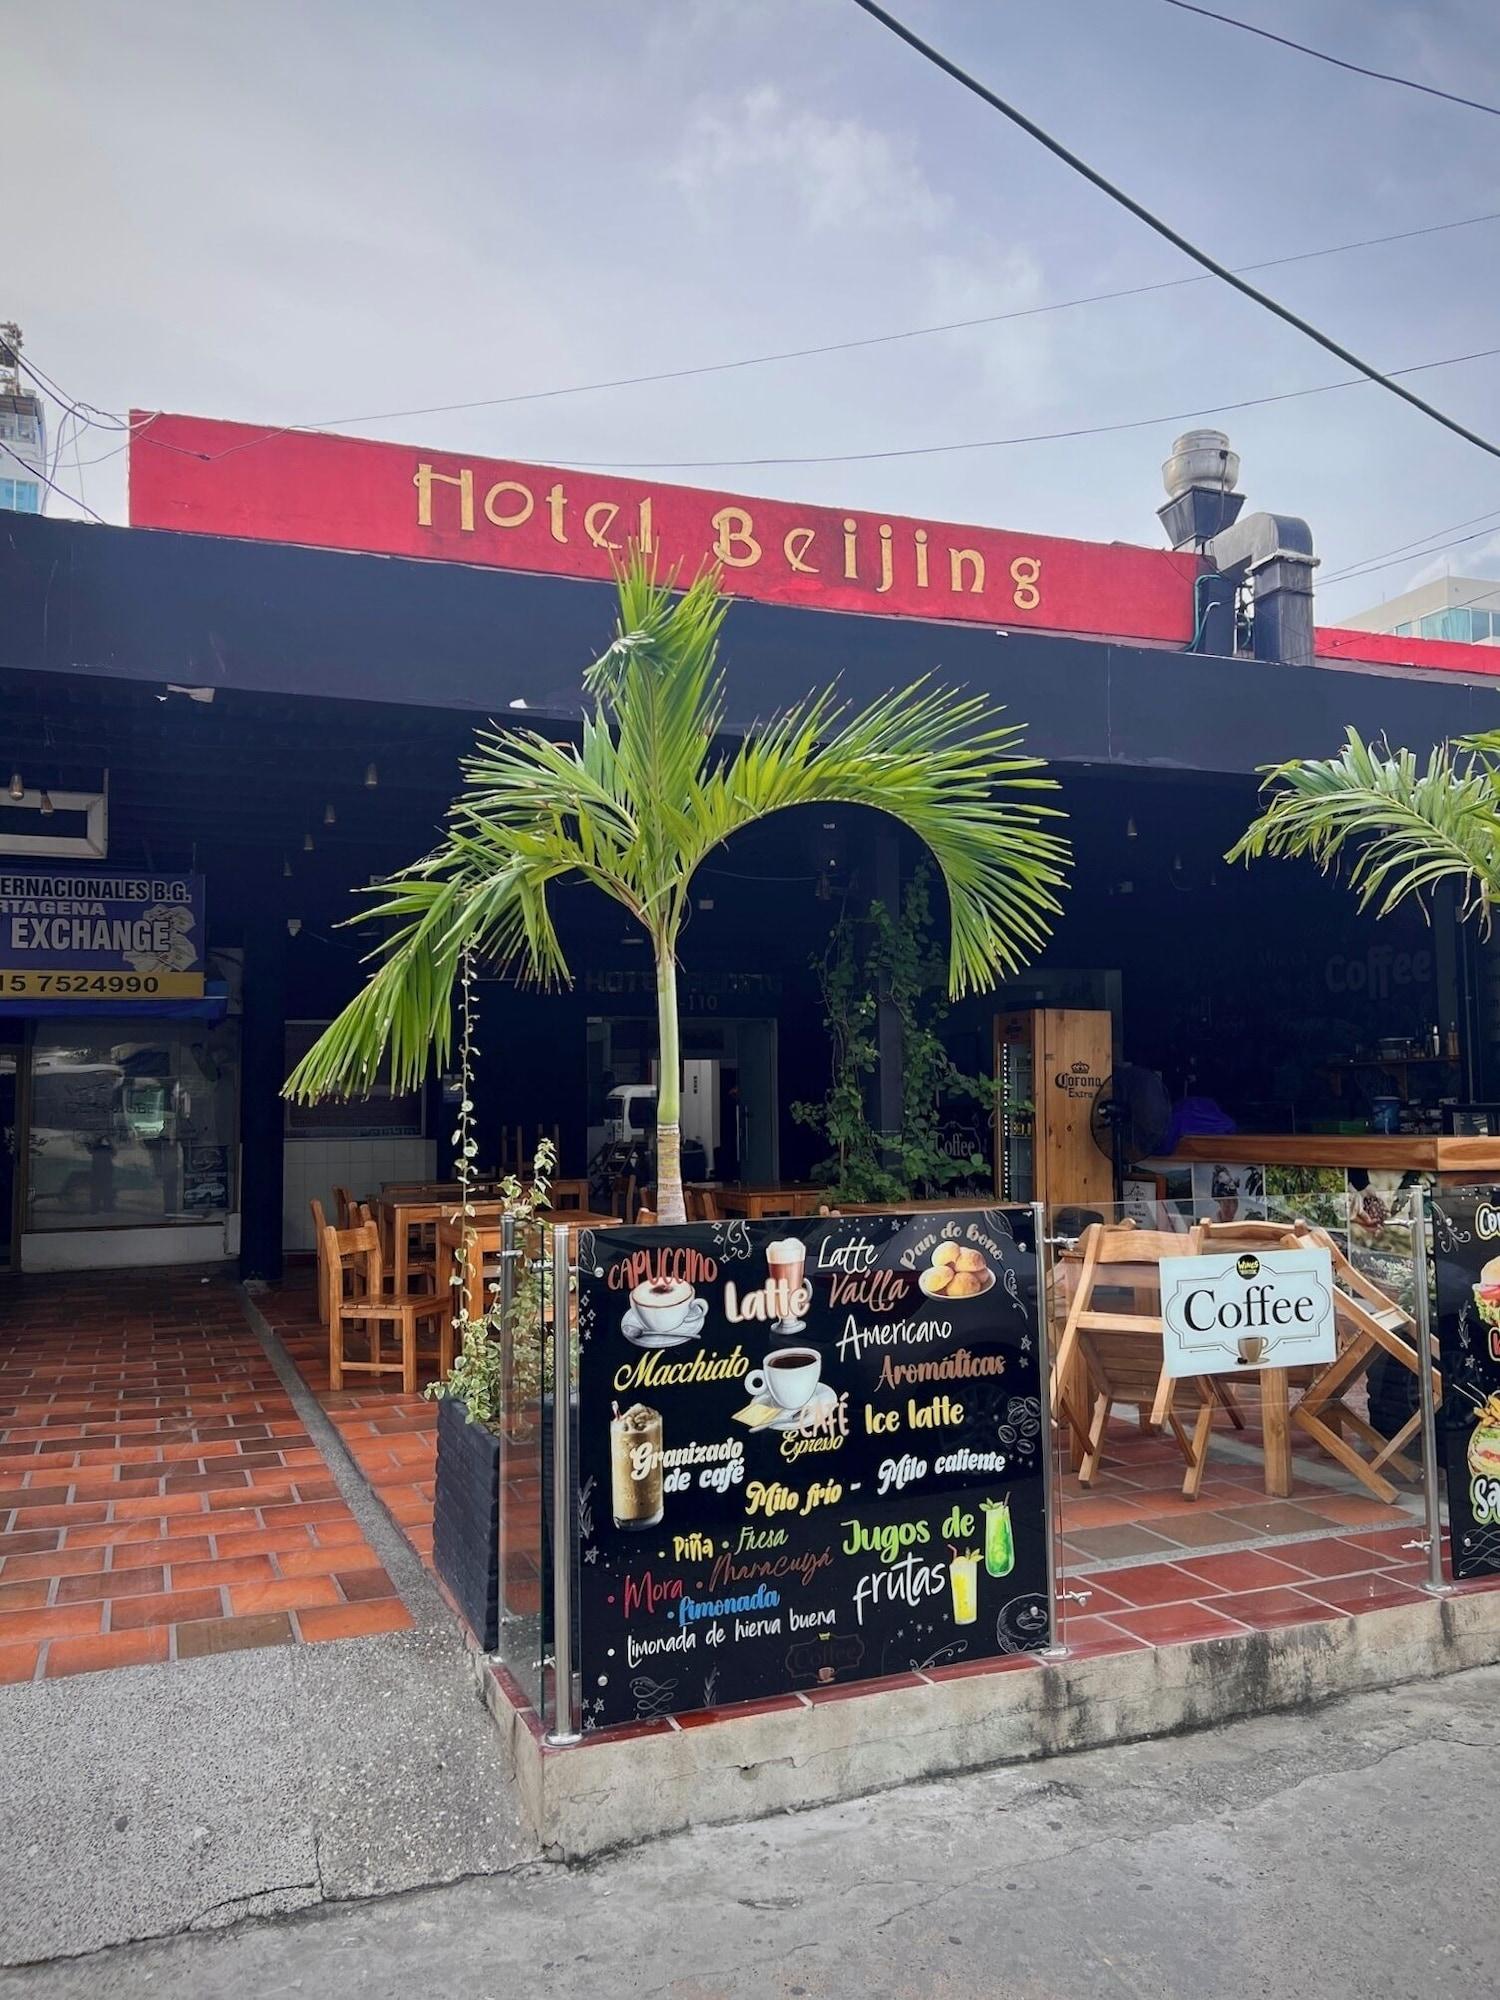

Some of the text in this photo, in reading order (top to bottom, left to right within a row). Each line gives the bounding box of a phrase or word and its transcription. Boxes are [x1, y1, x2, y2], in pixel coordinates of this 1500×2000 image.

[412, 463, 1042, 610] Hotel Beijing
[153, 881, 191, 901] B.G.
[11, 917, 171, 951] EXCHANGE
[37, 976, 159, 993] 7524990
[1325, 944, 1432, 1000] Coffee
[1055, 1073, 1103, 1089] Corona
[940, 1221, 962, 1239] de
[1480, 1208, 1500, 1236] Co
[817, 1235, 878, 1274] Latte
[725, 1278, 811, 1323] Latte
[1184, 1285, 1314, 1332] Coffee
[835, 1314, 952, 1363] Americano
[614, 1345, 749, 1391] Macchiato
[865, 1395, 964, 1435] Ice latte
[630, 1437, 743, 1481] Granizado
[663, 1458, 744, 1493] de café
[745, 1481, 799, 1517] Milo
[877, 1453, 928, 1495] Milo
[934, 1448, 1006, 1474] caliente
[672, 1532, 714, 1562] Piña
[840, 1505, 975, 1564] Jugos de
[624, 1571, 683, 1618] Mora
[679, 1583, 780, 1627] Limonada
[853, 1552, 945, 1626] frutas
[627, 1608, 836, 1669] Limonada de hierva buena
